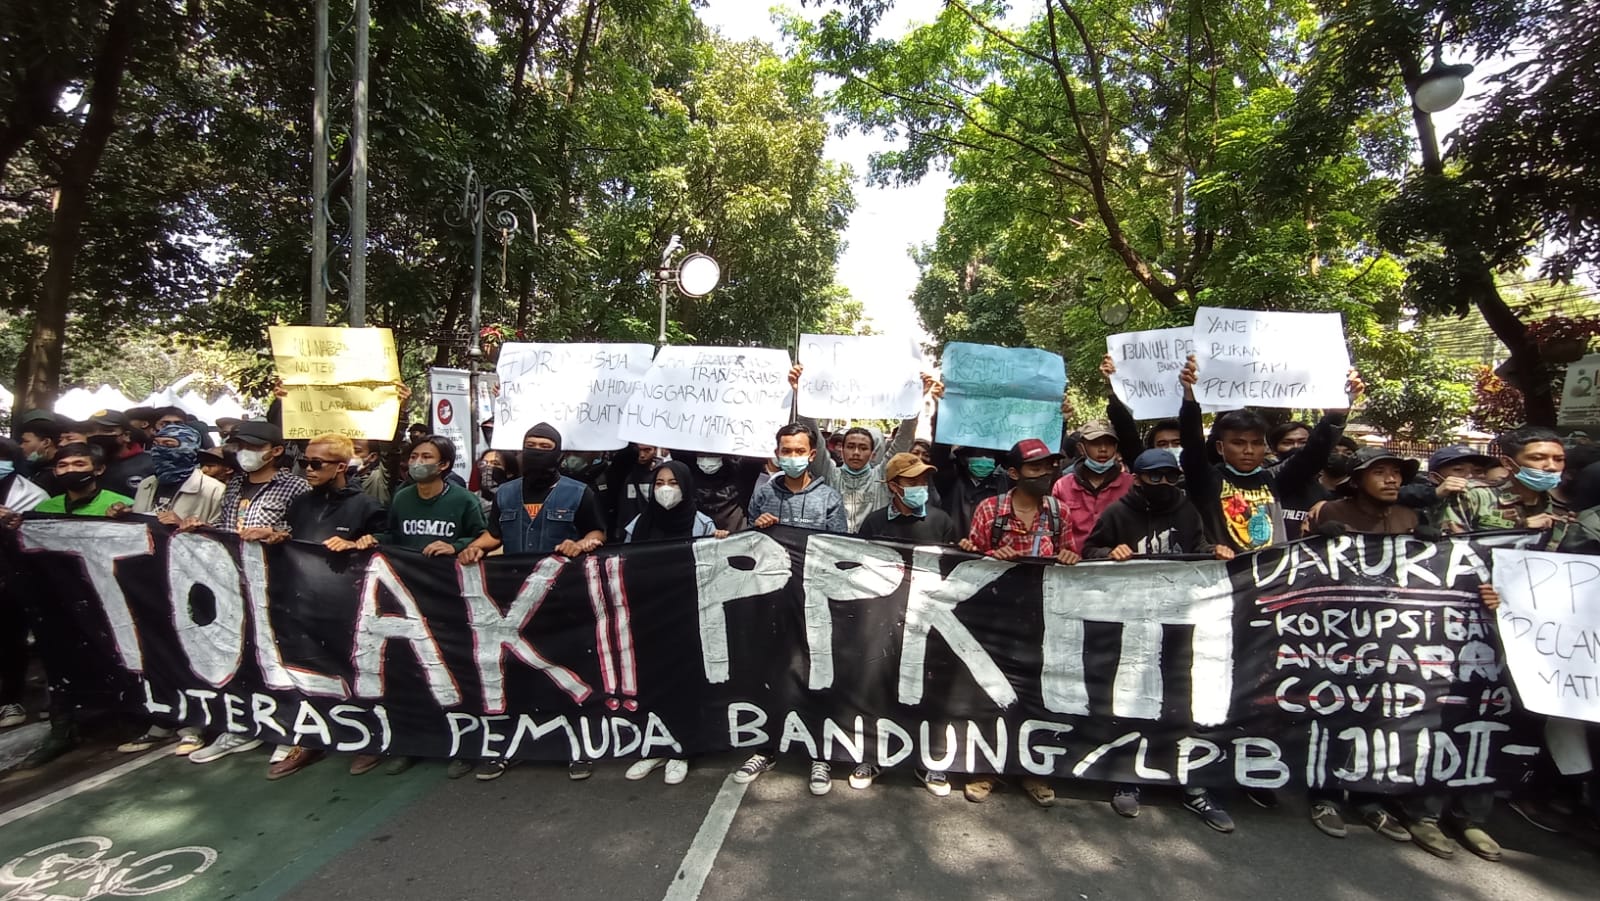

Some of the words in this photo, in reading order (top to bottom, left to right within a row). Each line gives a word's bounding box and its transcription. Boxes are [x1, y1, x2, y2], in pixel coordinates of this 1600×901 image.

[1207, 316, 1247, 334] YANG
[593, 351, 629, 370] SAJA
[1122, 339, 1170, 361] BUNUH
[1210, 341, 1261, 361] BUKAN
[1123, 379, 1165, 402] BUNUH
[1203, 376, 1318, 399] PEMERINTA
[626, 408, 696, 436] HUKUM
[402, 519, 456, 537] COSMIC
[692, 530, 1235, 727] PPKM
[143, 680, 392, 753] LITERASI
[446, 711, 683, 761] PEMUDA
